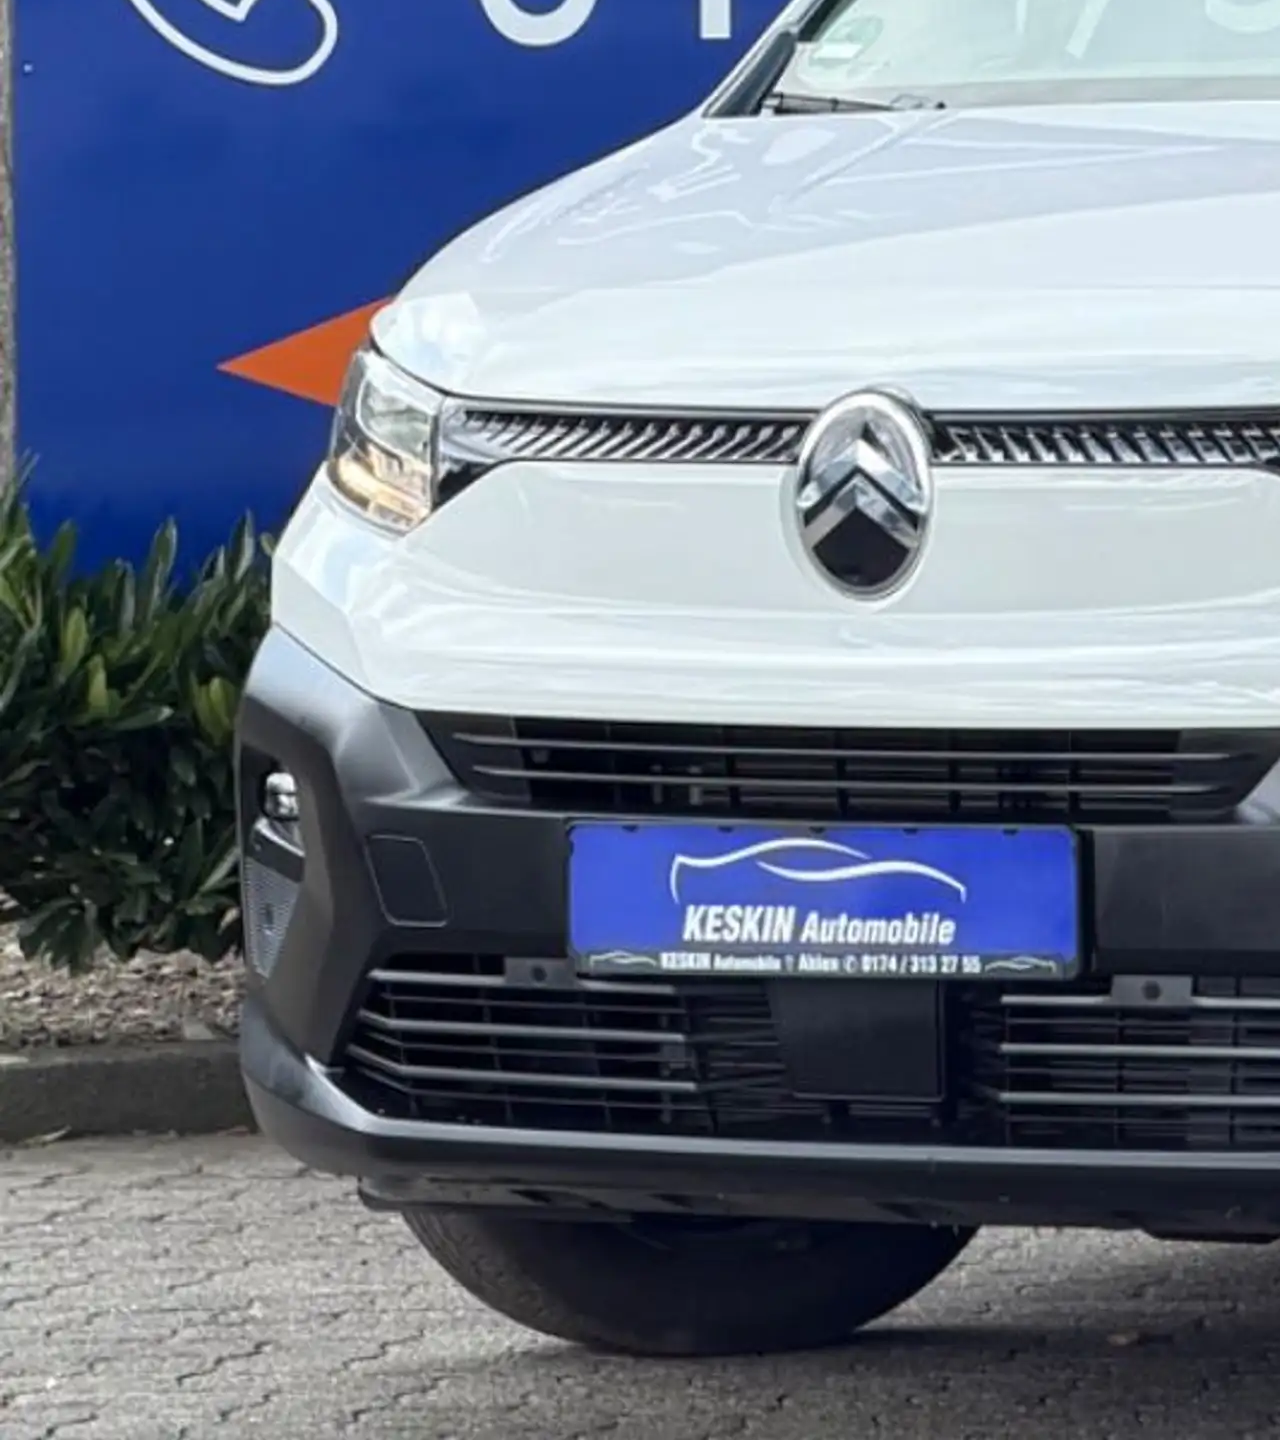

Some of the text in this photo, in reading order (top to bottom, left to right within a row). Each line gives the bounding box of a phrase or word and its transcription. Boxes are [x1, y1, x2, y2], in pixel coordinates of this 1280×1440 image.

[682, 905, 956, 945] KESKIN Automobile
[660, 953, 711, 969] KESKIN
